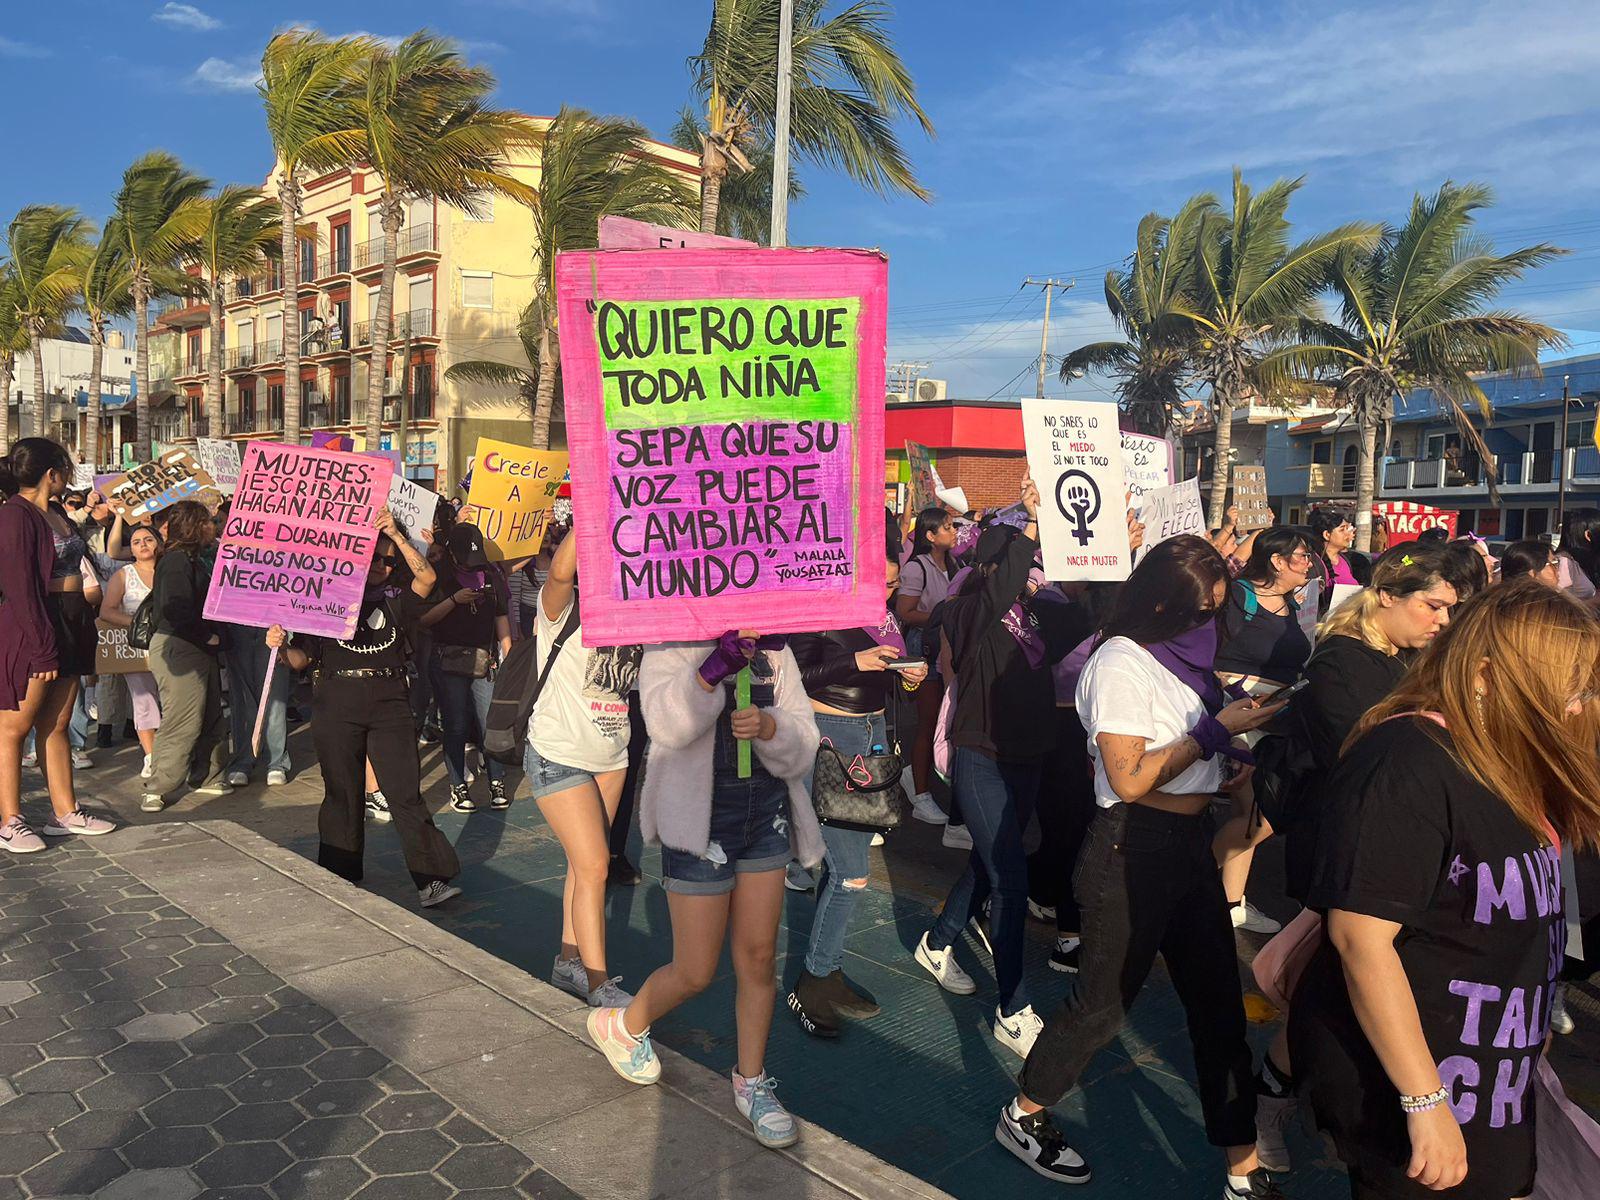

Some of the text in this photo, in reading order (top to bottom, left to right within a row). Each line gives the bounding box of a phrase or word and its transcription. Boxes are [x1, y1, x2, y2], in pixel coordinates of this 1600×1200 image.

[586, 299, 847, 361] "QUIERO QUE
[603, 354, 821, 408] TODA NIÑA
[1044, 415, 1098, 428] NO SABES LO
[1052, 428, 1087, 439] QUE ES
[616, 421, 839, 468] SEPA QUE SU
[1052, 441, 1096, 452] EL MIEDO
[126, 456, 164, 484] HOY
[1054, 454, 1109, 466] SI NO TE TOCO
[399, 481, 417, 500] MI
[507, 484, 521, 503] A
[612, 464, 820, 509] VOZ PUEDE
[306, 499, 373, 527] ARTE!
[468, 502, 546, 543] TU HIJA
[1386, 514, 1450, 534] TACOS
[226, 517, 371, 556] QUE DURANTE
[612, 502, 843, 558] CAMBIAR AL
[221, 543, 355, 577] SIGLOS NOS LO
[794, 548, 847, 562] MALALA
[1066, 555, 1118, 566] NACER MUJER
[218, 564, 333, 600] NEGARON"
[620, 548, 778, 600] MUNDO"
[774, 562, 853, 583] YOUSAFZAI
[590, 701, 603, 712] IN
